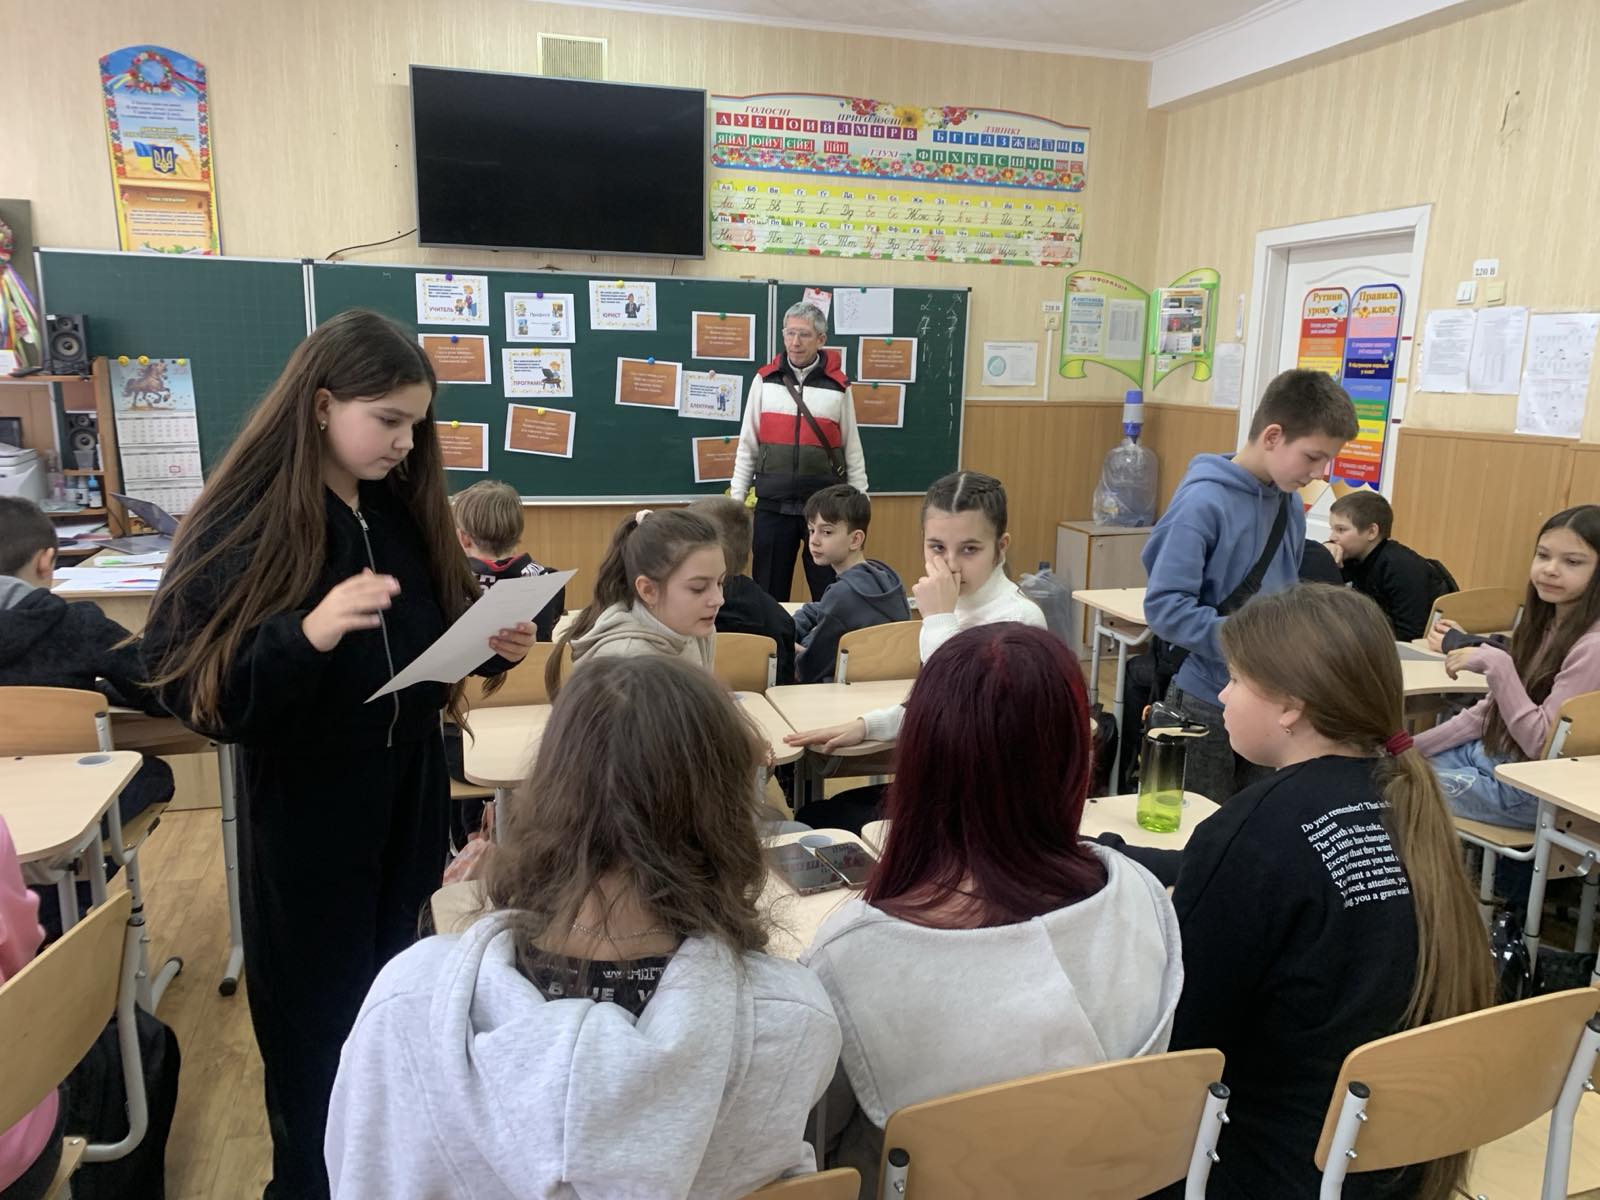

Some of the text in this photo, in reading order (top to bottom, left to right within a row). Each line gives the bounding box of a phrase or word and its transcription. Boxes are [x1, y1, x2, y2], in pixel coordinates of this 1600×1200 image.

[1313, 293, 1342, 303] Рутини
[1360, 292, 1398, 303] Правила
[1372, 306, 1396, 315] класу
[1301, 824, 1314, 832] Do
[1313, 815, 1329, 828] you
[1328, 803, 1364, 817] remember?
[1363, 801, 1380, 810] That
[1308, 822, 1338, 842] screams
[1313, 840, 1330, 852] The
[1329, 828, 1349, 842] truth
[1353, 825, 1366, 833] like
[1321, 846, 1337, 862] And
[1336, 839, 1354, 850] little
[1364, 832, 1390, 843] changed
[1349, 848, 1364, 858] that
[1363, 845, 1376, 855] they
[1376, 844, 1393, 852] want
[1331, 867, 1346, 880] But
[1371, 857, 1384, 866] you
[1383, 853, 1396, 862] and
[1371, 867, 1384, 876] war
[1348, 882, 1366, 893] seek
[1367, 877, 1398, 889] attention,
[1354, 894, 1371, 905] you
[1379, 890, 1397, 900] grave
